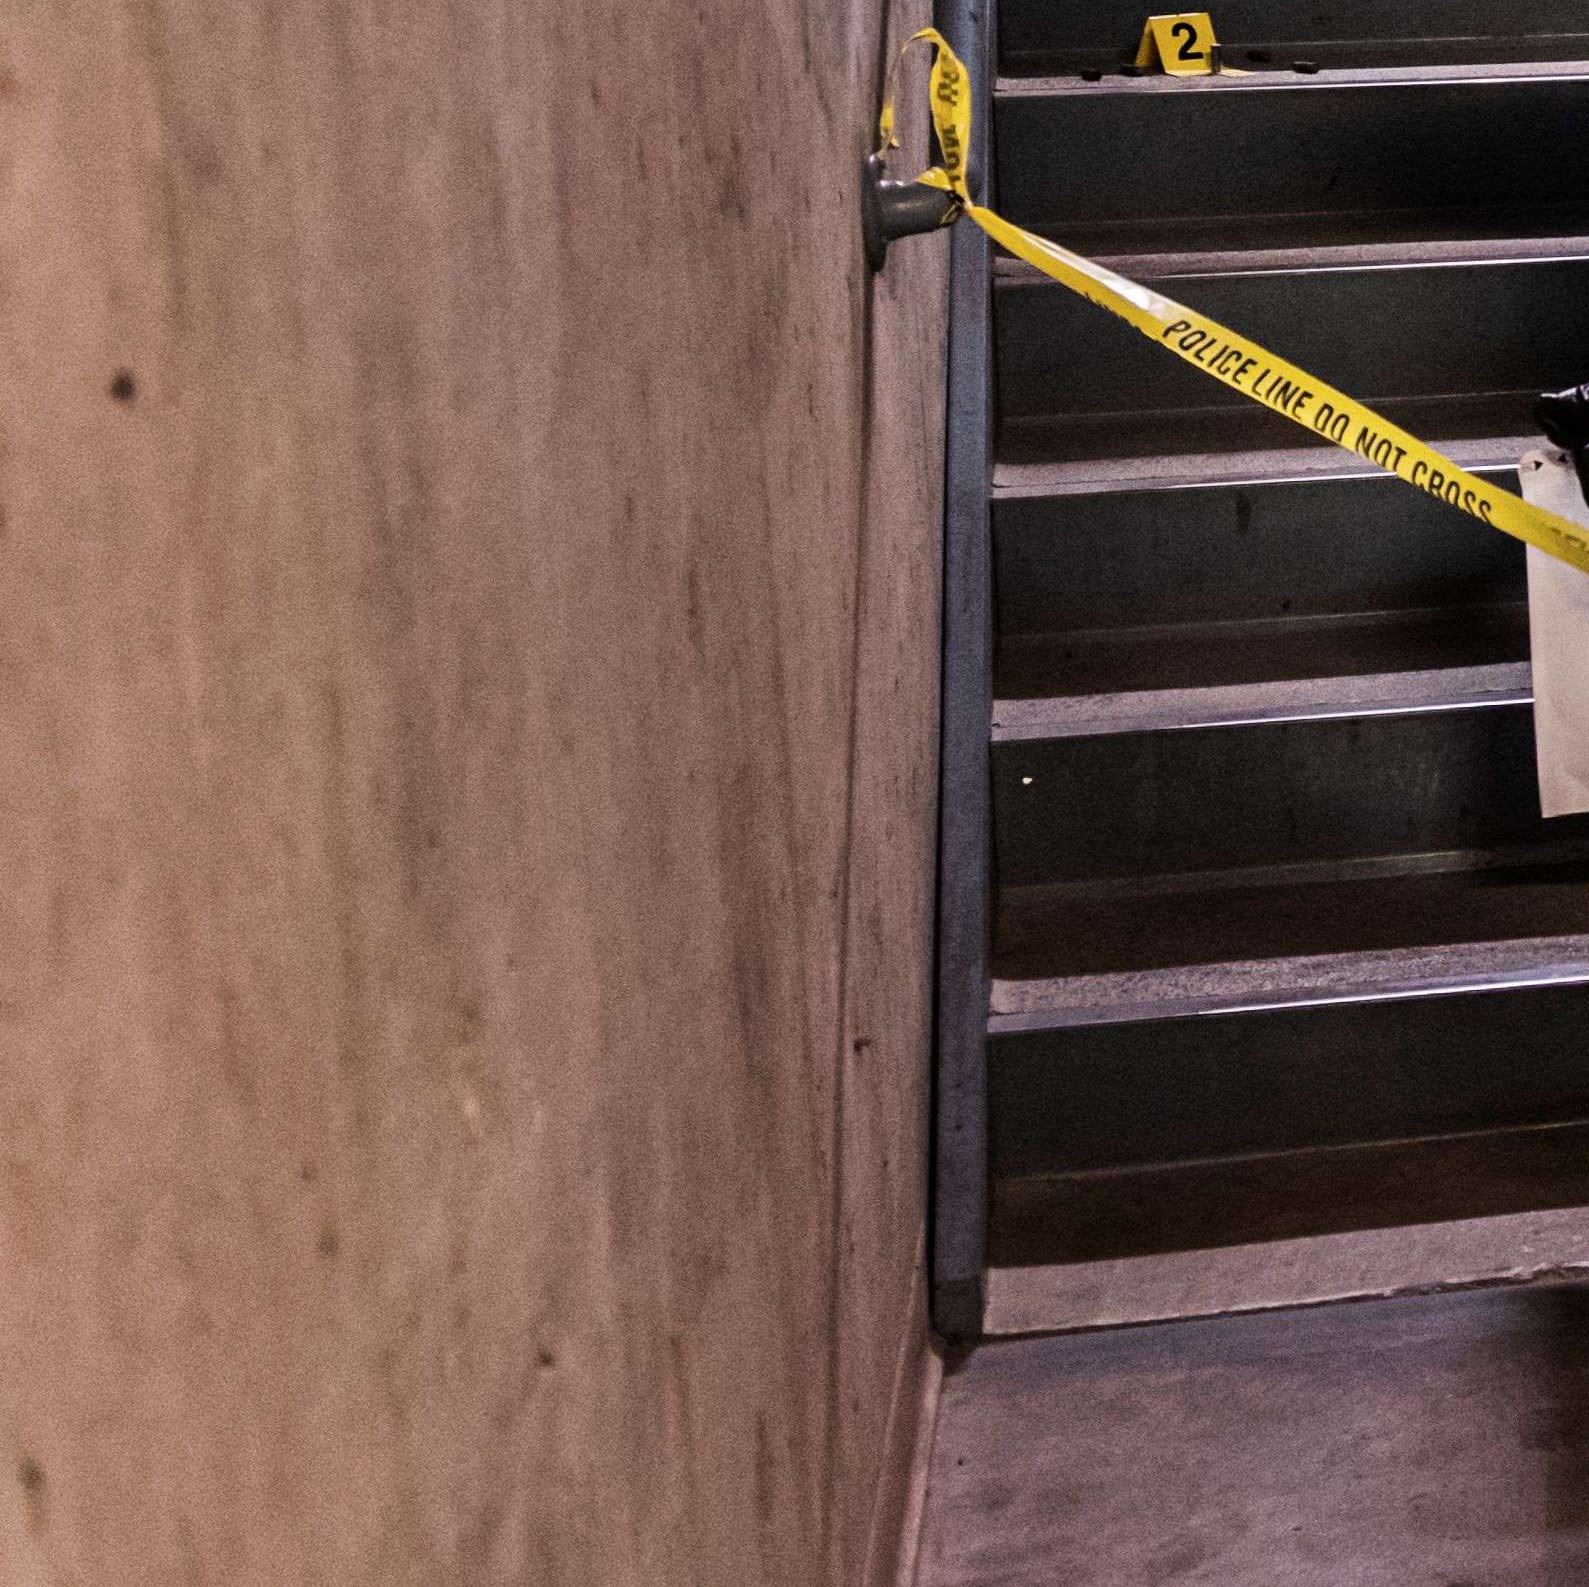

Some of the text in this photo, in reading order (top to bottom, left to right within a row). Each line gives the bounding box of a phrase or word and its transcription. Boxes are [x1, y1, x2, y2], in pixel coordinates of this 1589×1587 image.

[1171, 22, 1204, 61] 2
[1162, 319, 1492, 525] POLICE LINE DO NOT CROSS
